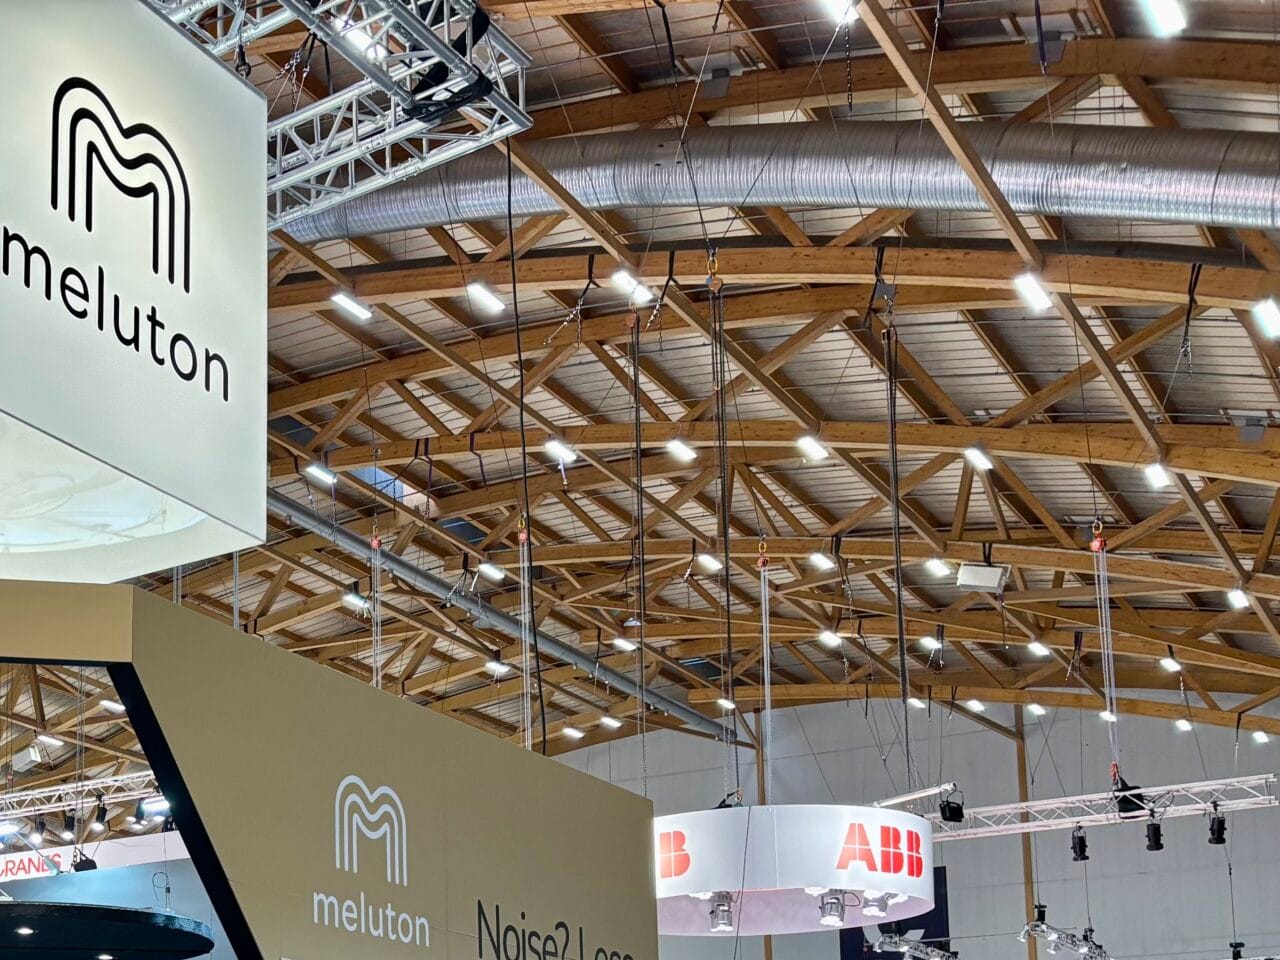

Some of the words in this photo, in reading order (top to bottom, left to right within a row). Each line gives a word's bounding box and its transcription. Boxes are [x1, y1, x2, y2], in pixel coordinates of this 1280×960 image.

[1, 225, 230, 402] meluton
[835, 822, 924, 878] ABB
[312, 891, 431, 947] meluton
